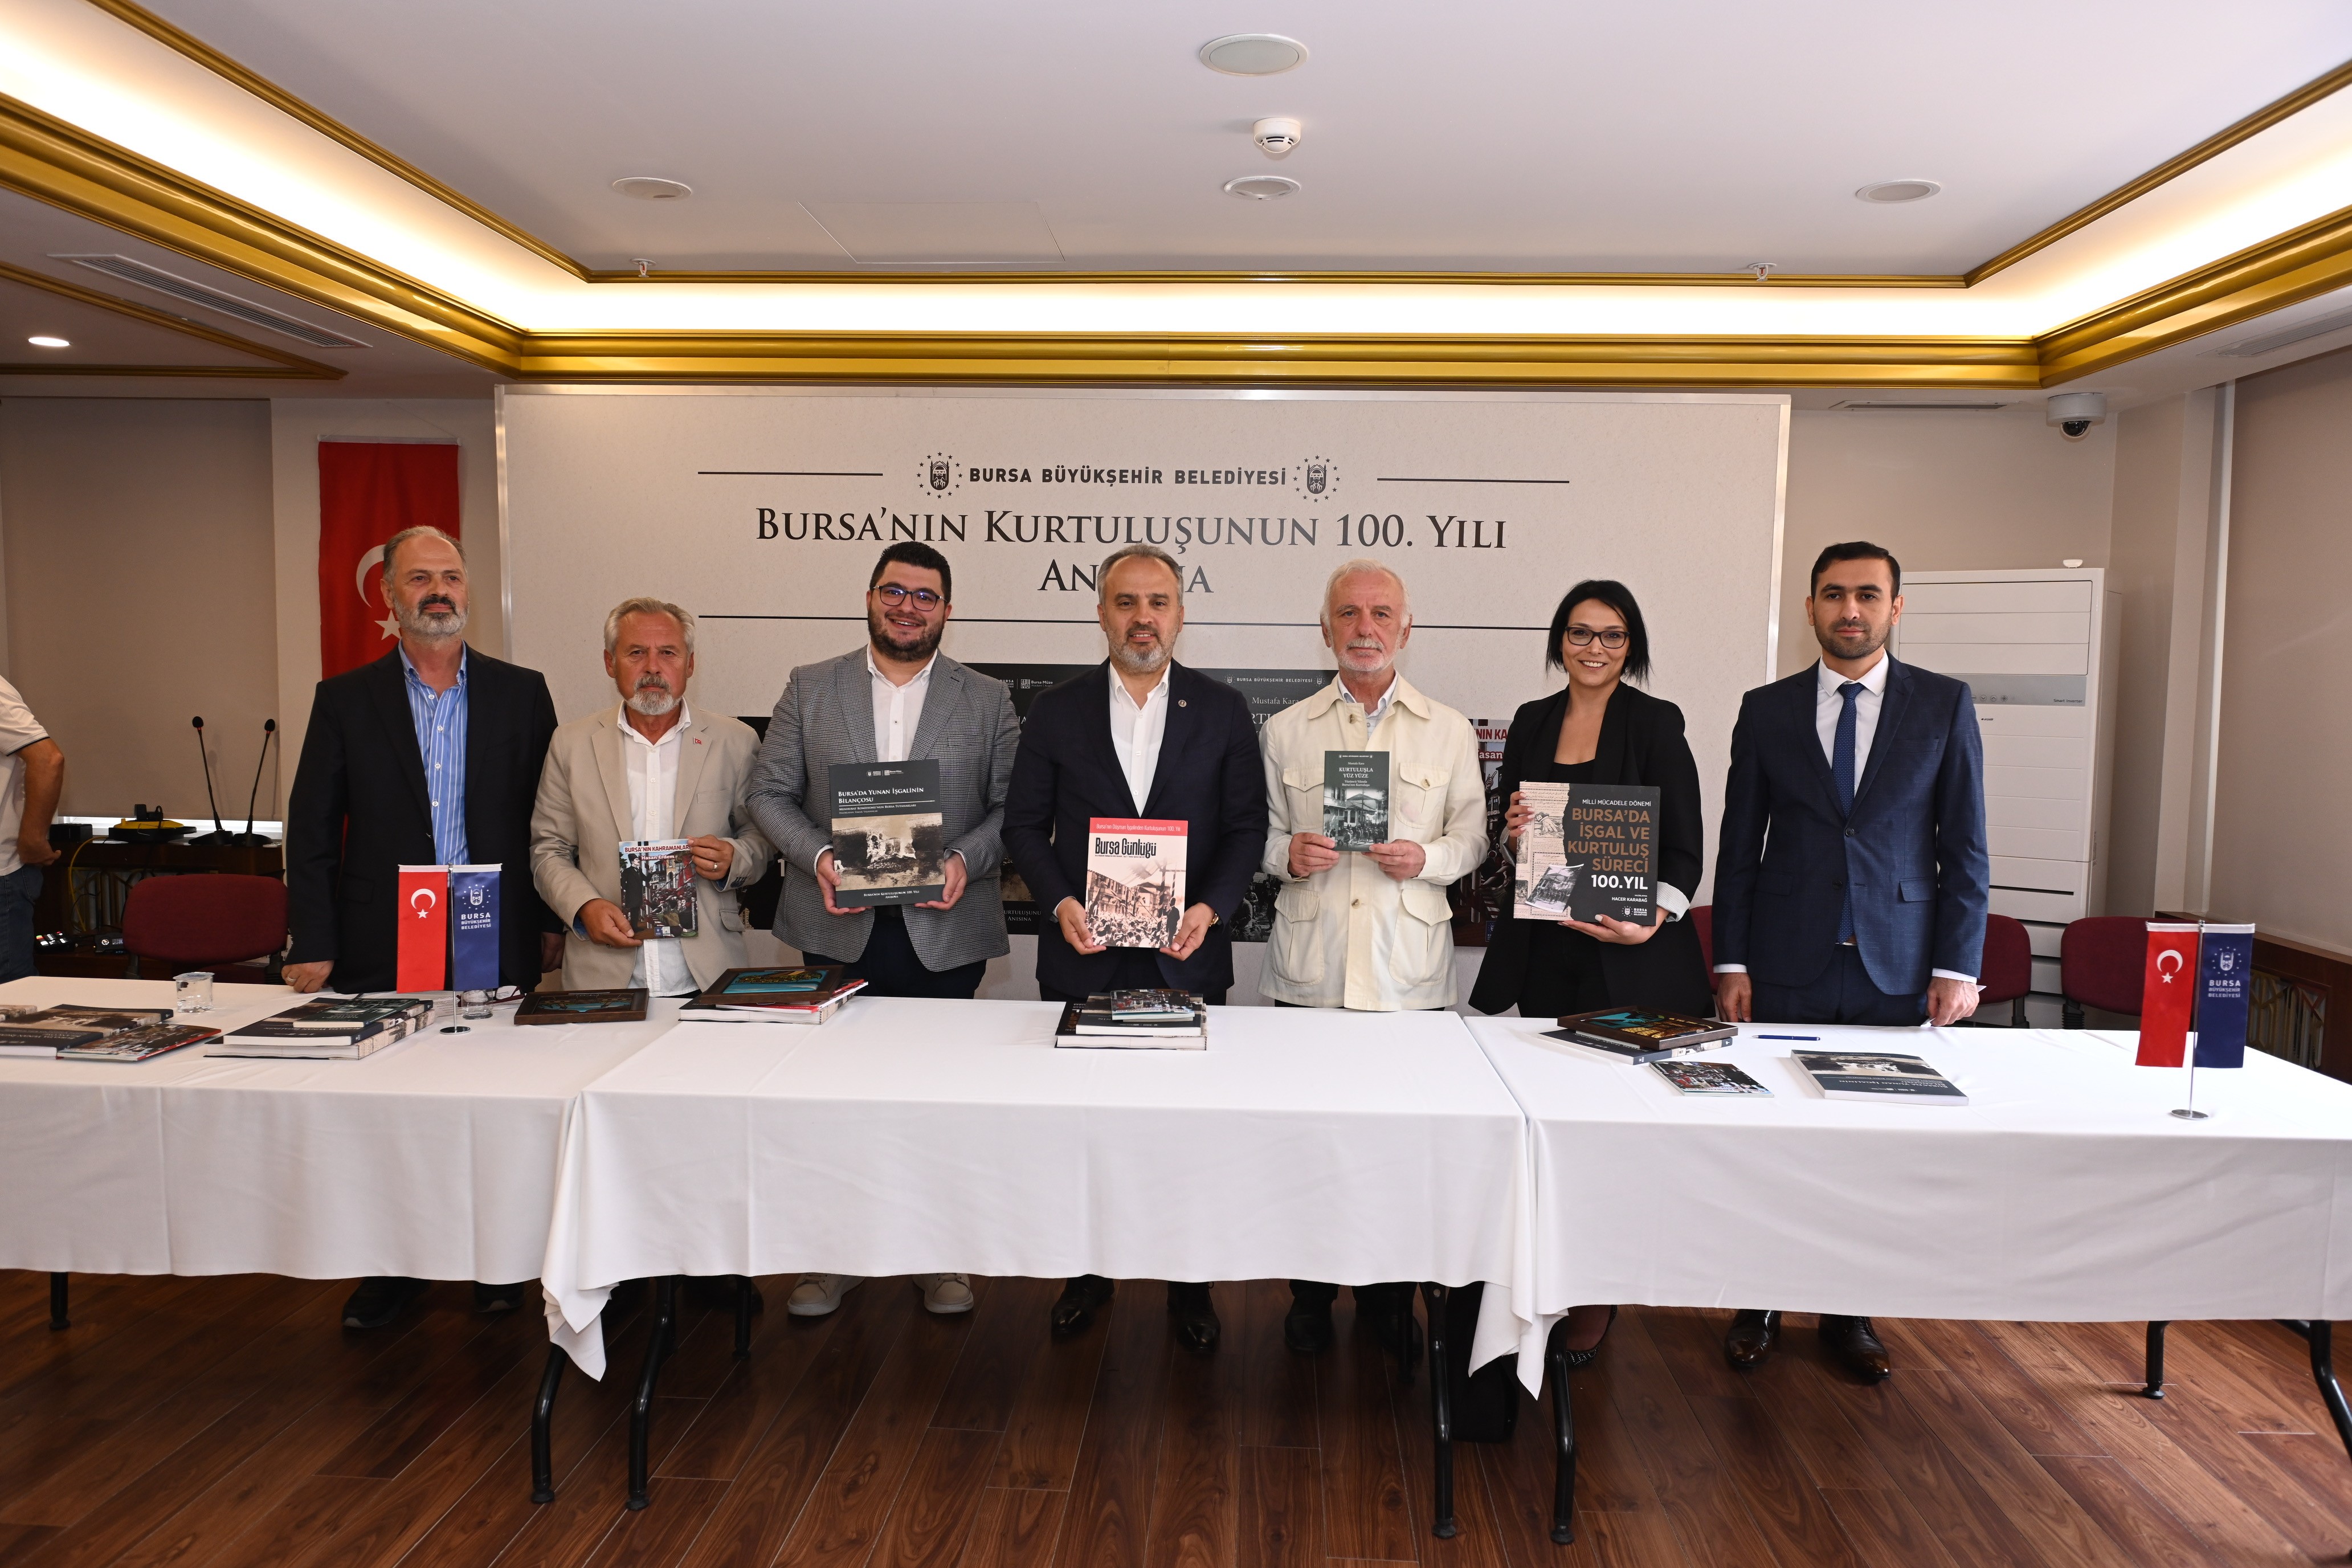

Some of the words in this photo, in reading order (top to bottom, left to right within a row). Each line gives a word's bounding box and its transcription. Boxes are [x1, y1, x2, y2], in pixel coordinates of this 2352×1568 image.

[970, 468, 1032, 483] BURSA
[1042, 466, 1163, 487] BÜYÜKŞEHİR
[1175, 466, 1287, 485] BELEDİYESİ
[985, 511, 1318, 554] KURTULUŞUNUN
[1337, 514, 1414, 548] 100.
[1427, 514, 1507, 549] YILI
[1580, 822, 1624, 839] İŞGAL
[1630, 826, 1649, 840] VE
[1095, 838, 1120, 855] Bursa
[1122, 838, 1157, 859] Günlüğü
[1568, 840, 1649, 858] KURTULUŞ
[1592, 856, 1648, 873] SÜRECİ
[1591, 875, 1648, 890] 100.YIL
